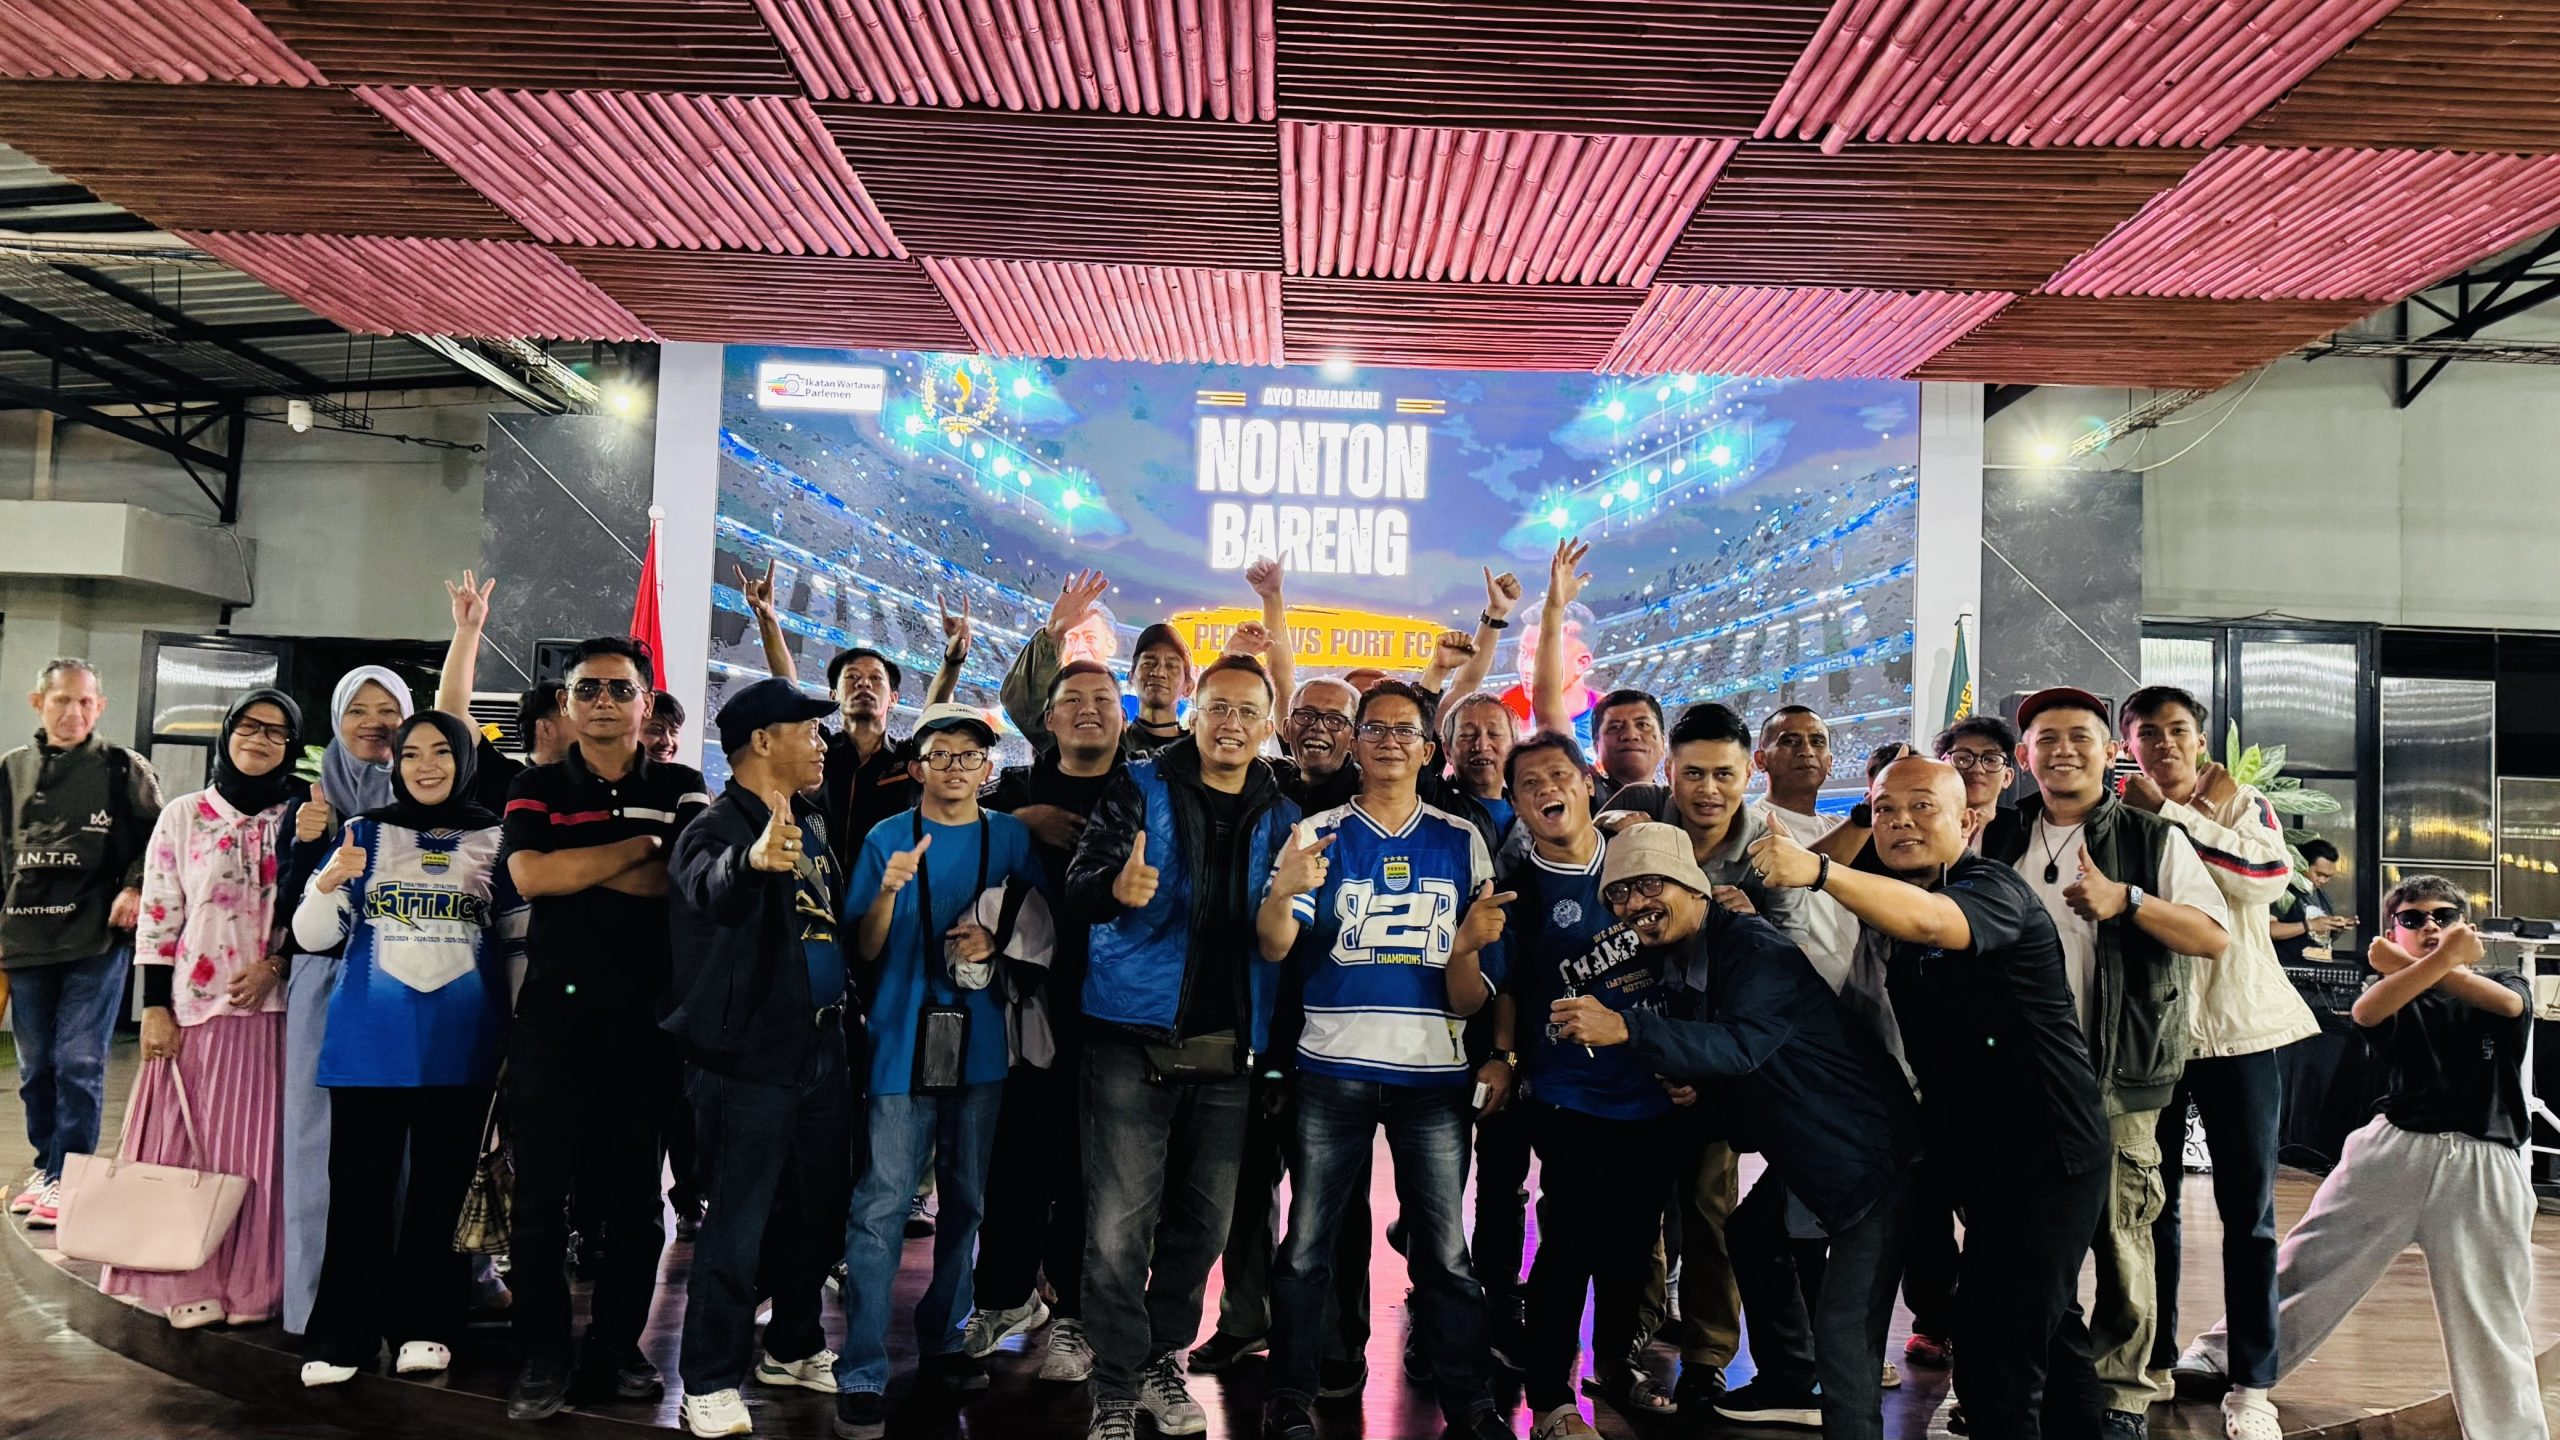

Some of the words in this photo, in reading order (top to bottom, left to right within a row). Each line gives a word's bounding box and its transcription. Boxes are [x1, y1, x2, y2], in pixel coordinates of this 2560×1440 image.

[805, 378, 836, 388] Ikatan
[837, 380, 881, 390] Wartawan
[1263, 387, 1293, 406] AYO
[1296, 389, 1380, 410] RAMAIKAN!
[1199, 417, 1428, 499] NONTON
[1211, 502, 1408, 577] BARENG
[1290, 627, 1321, 655] VS
[1331, 628, 1395, 657] PORT
[1404, 631, 1432, 658] FC
[1592, 931, 1606, 943] WE
[1606, 922, 1626, 938] ARE
[1376, 952, 1422, 966] CHAMPIONS
[1558, 929, 1641, 985] CHAMP
